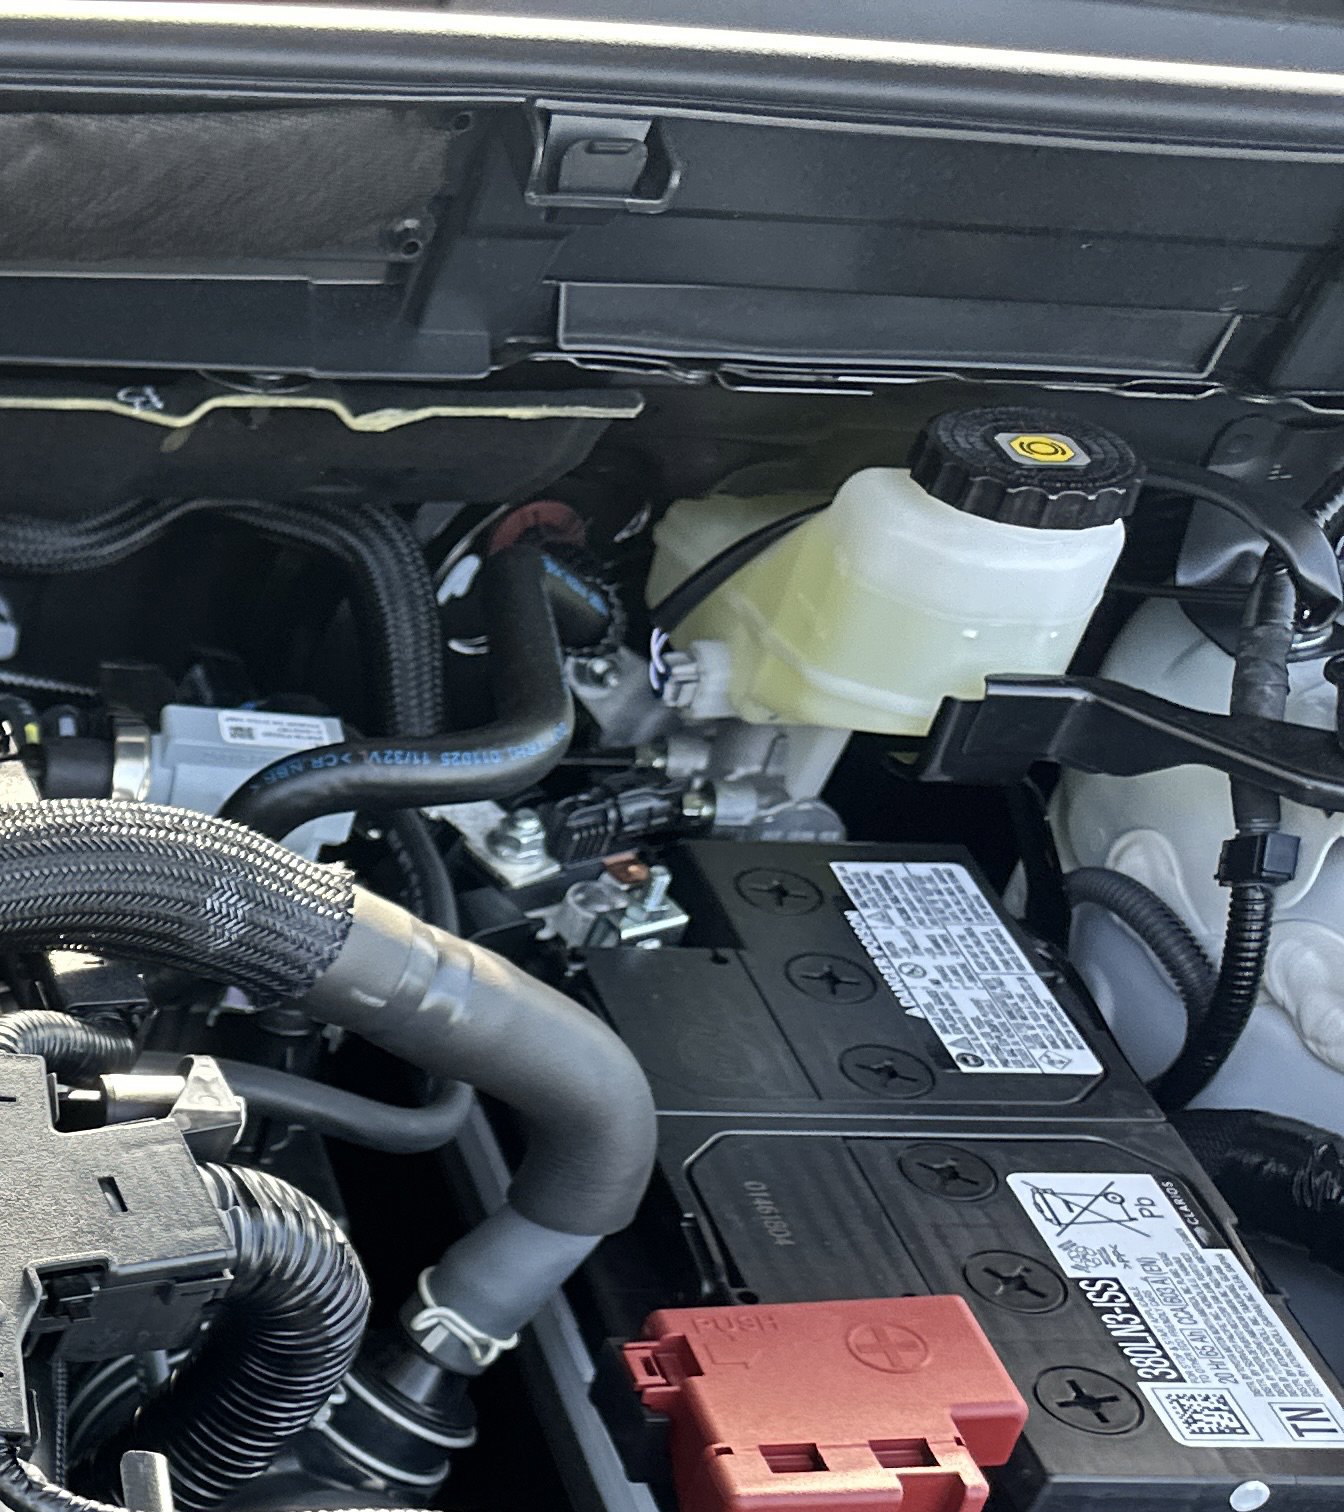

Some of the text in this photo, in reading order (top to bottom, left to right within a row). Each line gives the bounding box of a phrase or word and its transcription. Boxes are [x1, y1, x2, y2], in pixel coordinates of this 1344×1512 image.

[1134, 1197, 1165, 1218] Pb
[1161, 1181, 1200, 1225] CLARIOS
[691, 1315, 780, 1333] PUSH
[1079, 1280, 1177, 1379] 380LN3-ISS
[1277, 1406, 1339, 1438] TN
